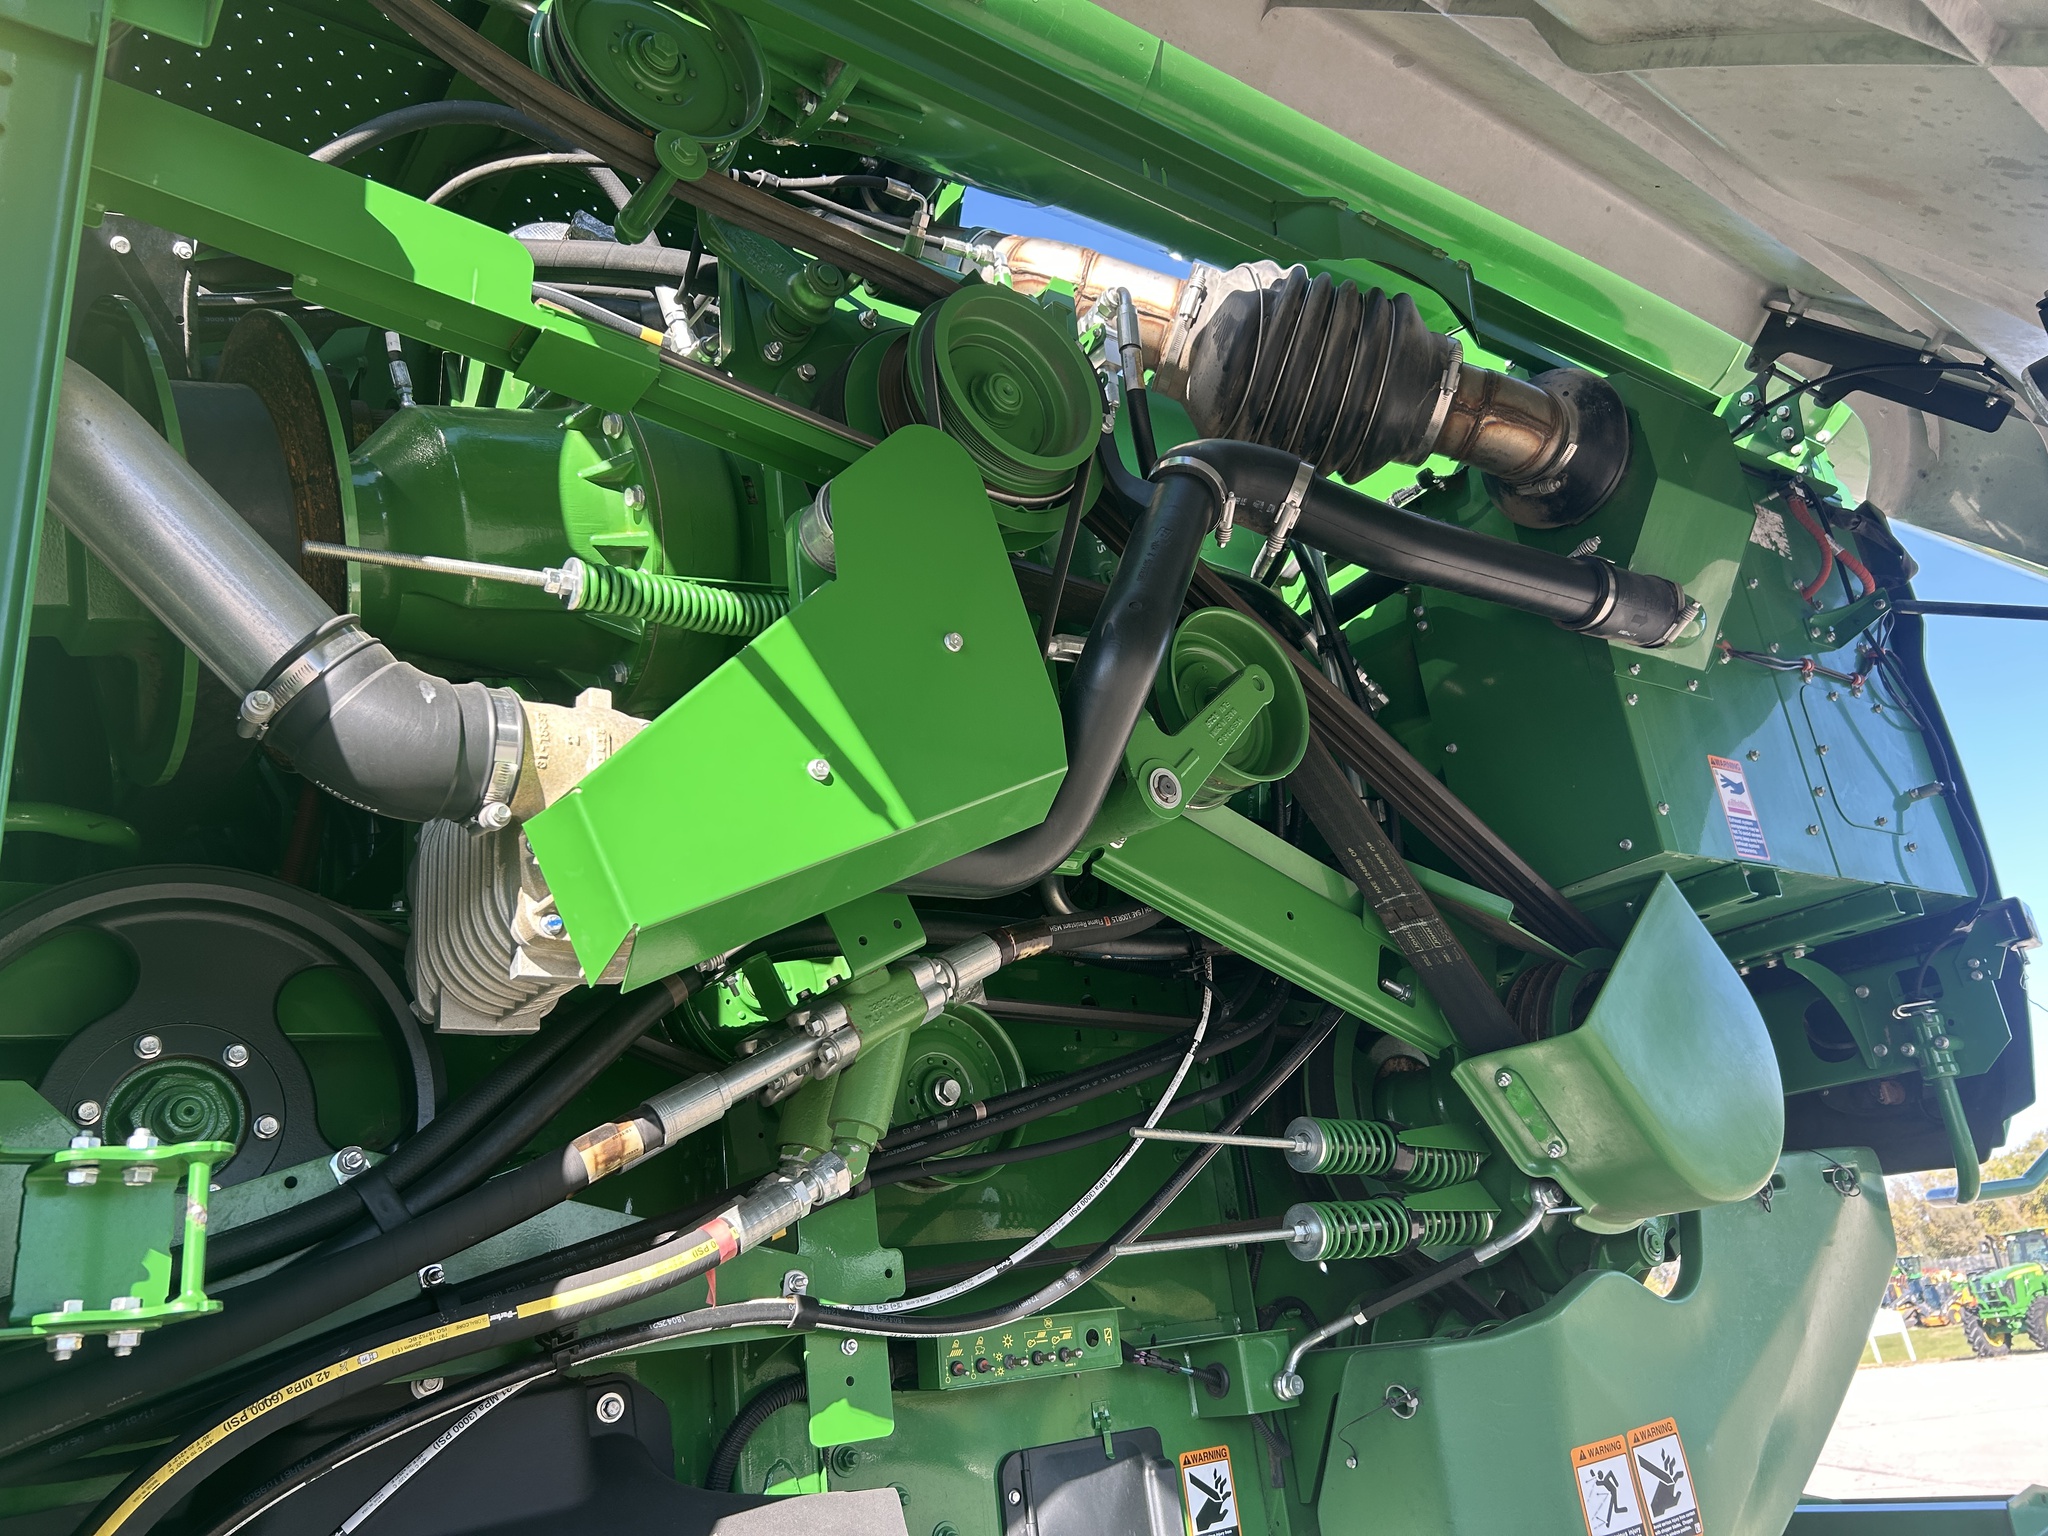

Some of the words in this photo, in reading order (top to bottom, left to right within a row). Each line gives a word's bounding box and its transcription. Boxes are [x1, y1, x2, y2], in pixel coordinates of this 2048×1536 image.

[1713, 757, 1741, 771] WARNING
[1087, 917, 1104, 926] Flame
[1094, 1177, 1109, 1192] MPa
[1079, 1189, 1097, 1207] (3000
[1068, 1204, 1082, 1219] PSI)
[314, 1368, 332, 1384] 42
[285, 1377, 315, 1397] MPa
[248, 1390, 286, 1418] (6000
[477, 1392, 500, 1414] MPa
[221, 1411, 250, 1433] PSI)
[451, 1409, 478, 1434] (3000
[431, 1430, 453, 1451] PSI)
[1640, 1422, 1673, 1441] WARNING
[1190, 1448, 1227, 1463] WARNING
[1587, 1441, 1622, 1457] WARNING
